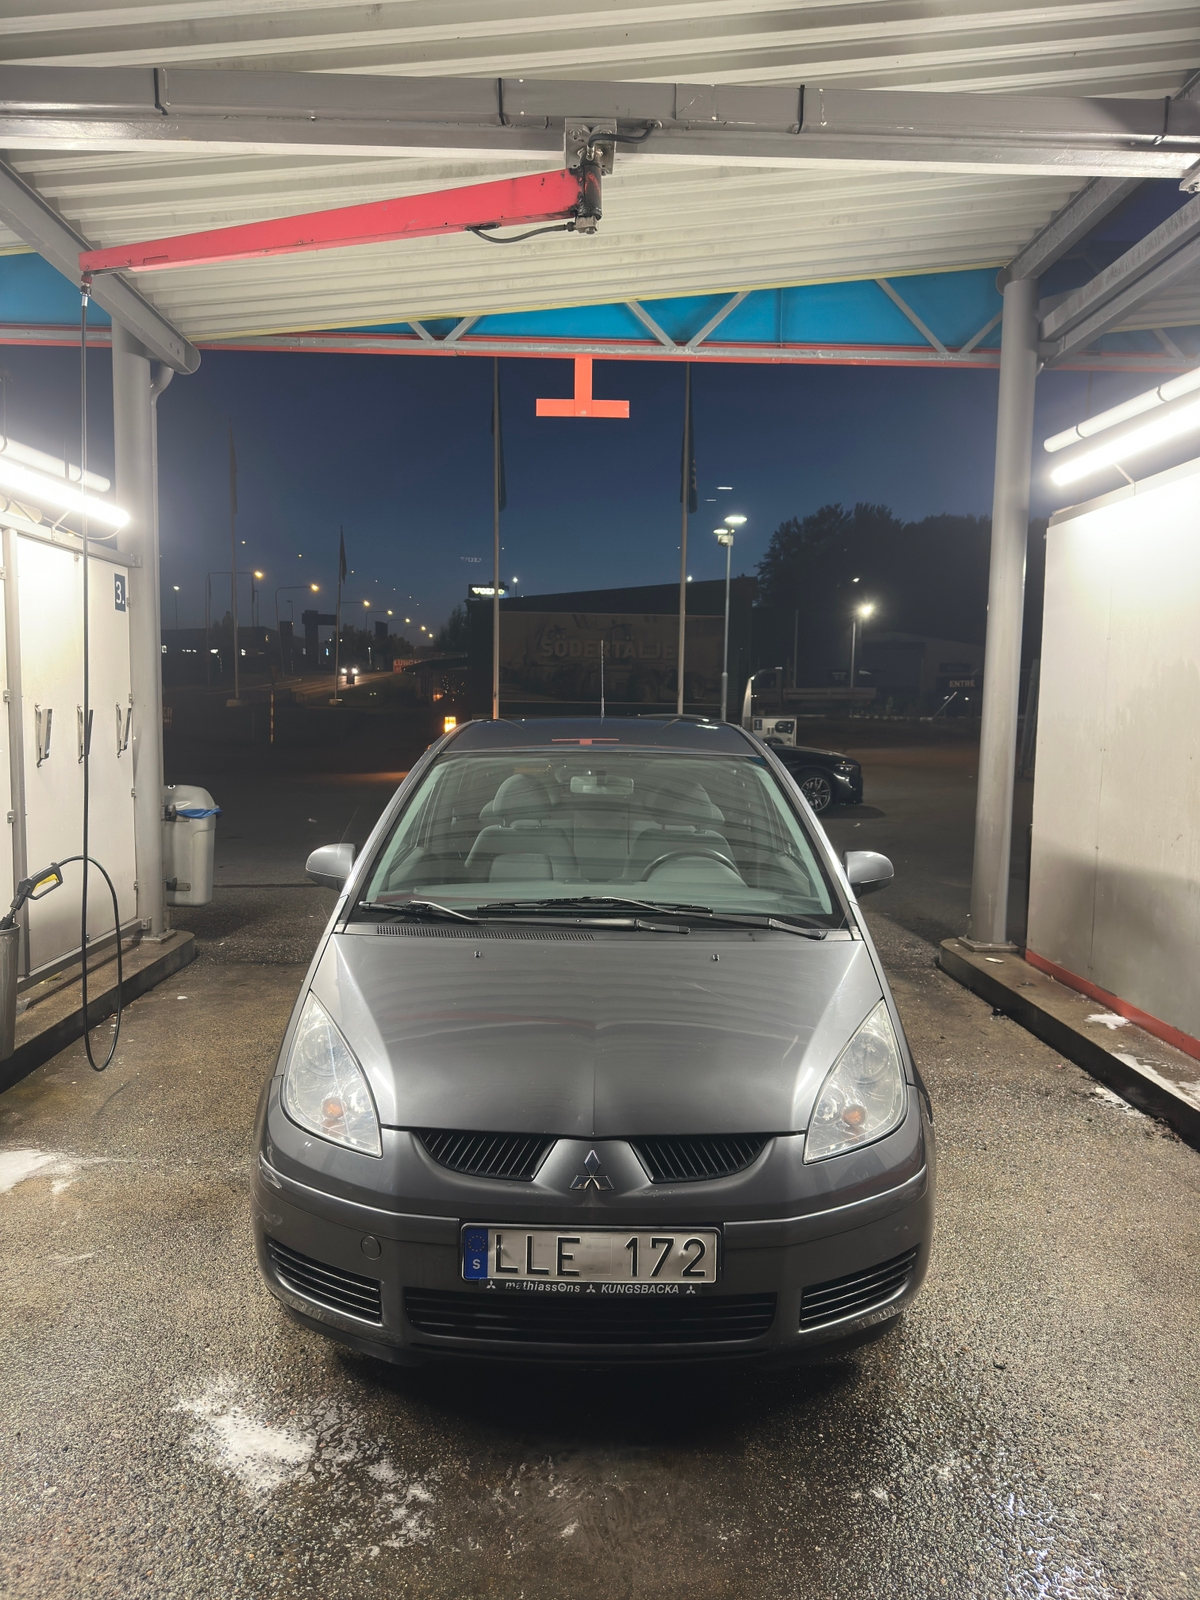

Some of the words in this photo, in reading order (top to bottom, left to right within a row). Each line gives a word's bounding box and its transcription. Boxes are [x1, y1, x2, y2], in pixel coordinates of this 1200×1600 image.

[494, 1233, 582, 1277] LLE
[624, 1236, 707, 1278] 172
[471, 1257, 481, 1270] S
[600, 1283, 681, 1295] KUNGSBACKA
